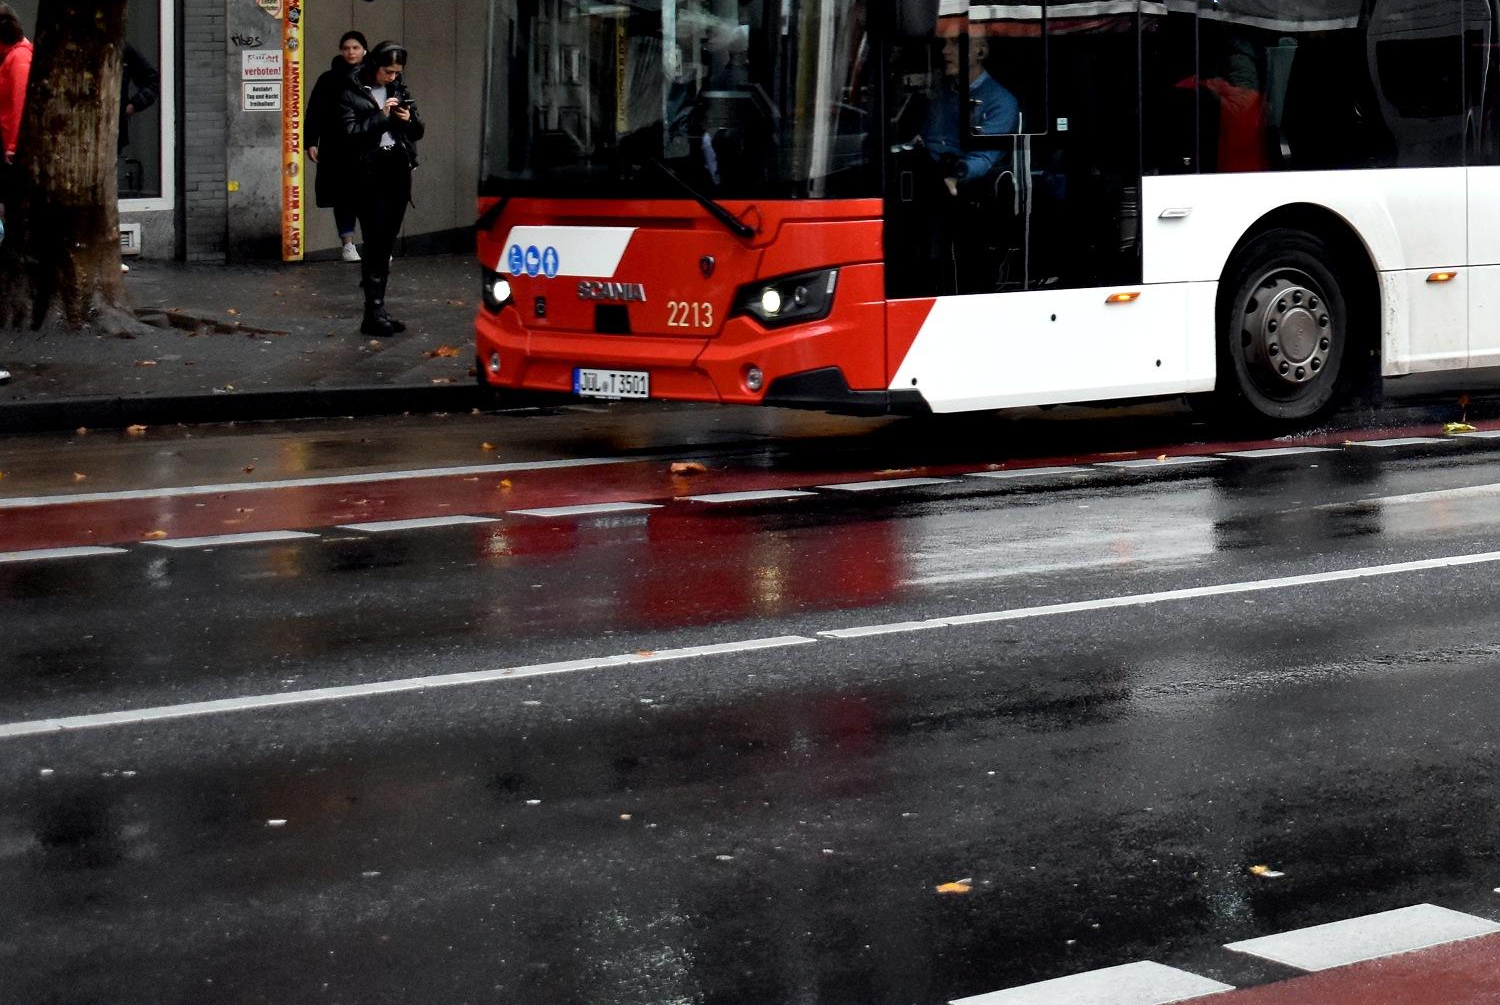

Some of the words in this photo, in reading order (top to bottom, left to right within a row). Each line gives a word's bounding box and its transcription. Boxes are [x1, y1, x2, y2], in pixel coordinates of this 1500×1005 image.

[245, 67, 281, 76] verboten!
[284, 186, 299, 209] WIN
[284, 227, 299, 256] PLAY
[577, 282, 647, 302] SCANIA
[667, 301, 713, 327] 2213
[619, 374, 646, 395] 3501
